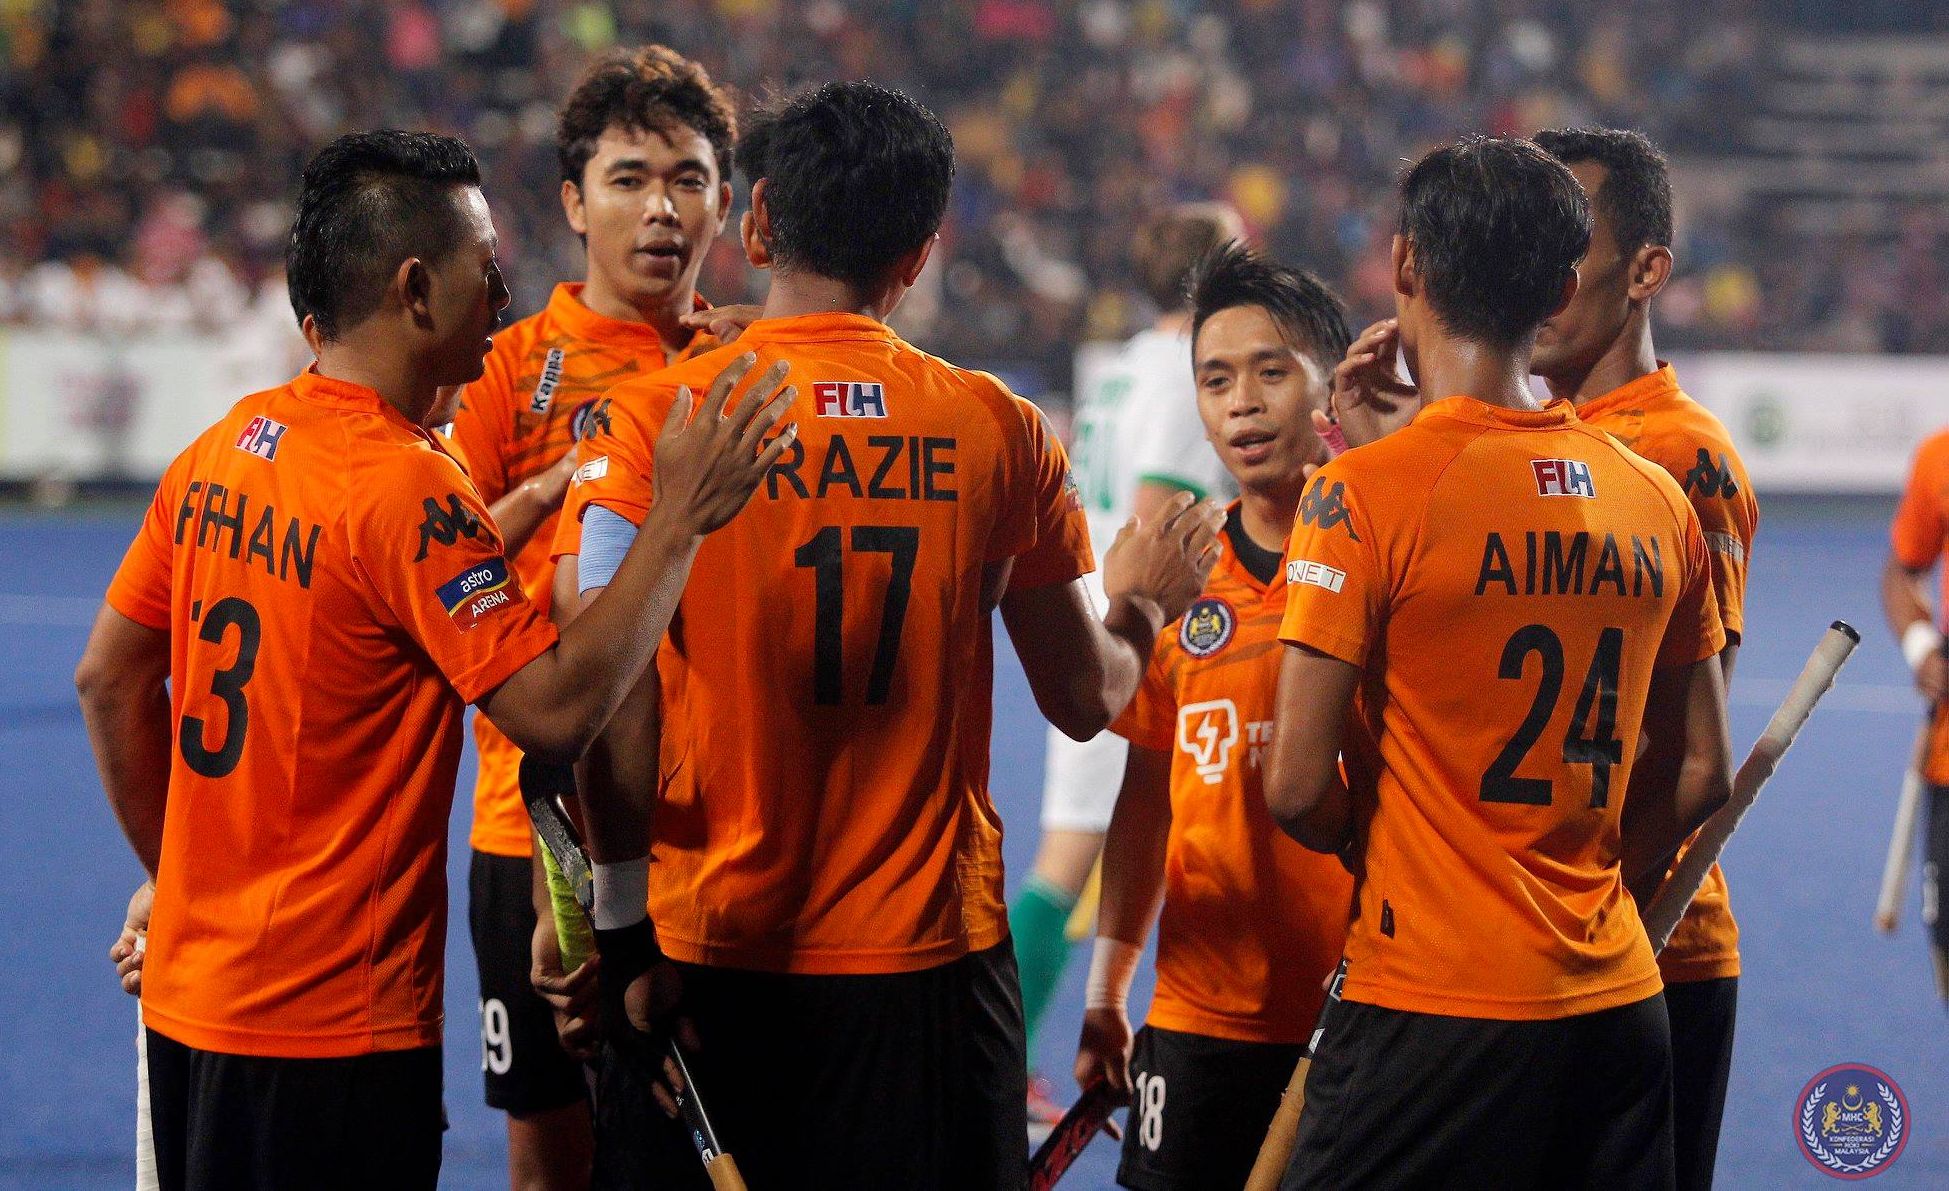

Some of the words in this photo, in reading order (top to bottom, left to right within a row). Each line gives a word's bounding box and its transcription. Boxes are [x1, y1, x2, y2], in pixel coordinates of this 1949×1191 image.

[531, 350, 563, 412] Kappa
[813, 382, 887, 417] FIH
[236, 417, 287, 460] FIH
[762, 434, 958, 501] RAZIE
[1534, 459, 1595, 497] FIH
[460, 569, 493, 593] astro
[1474, 530, 1665, 598] AIMAN
[471, 590, 509, 618] ARENA
[794, 525, 919, 706] 17
[179, 596, 261, 778] 3
[1478, 623, 1624, 808] 24
[1136, 1071, 1166, 1151] 18
